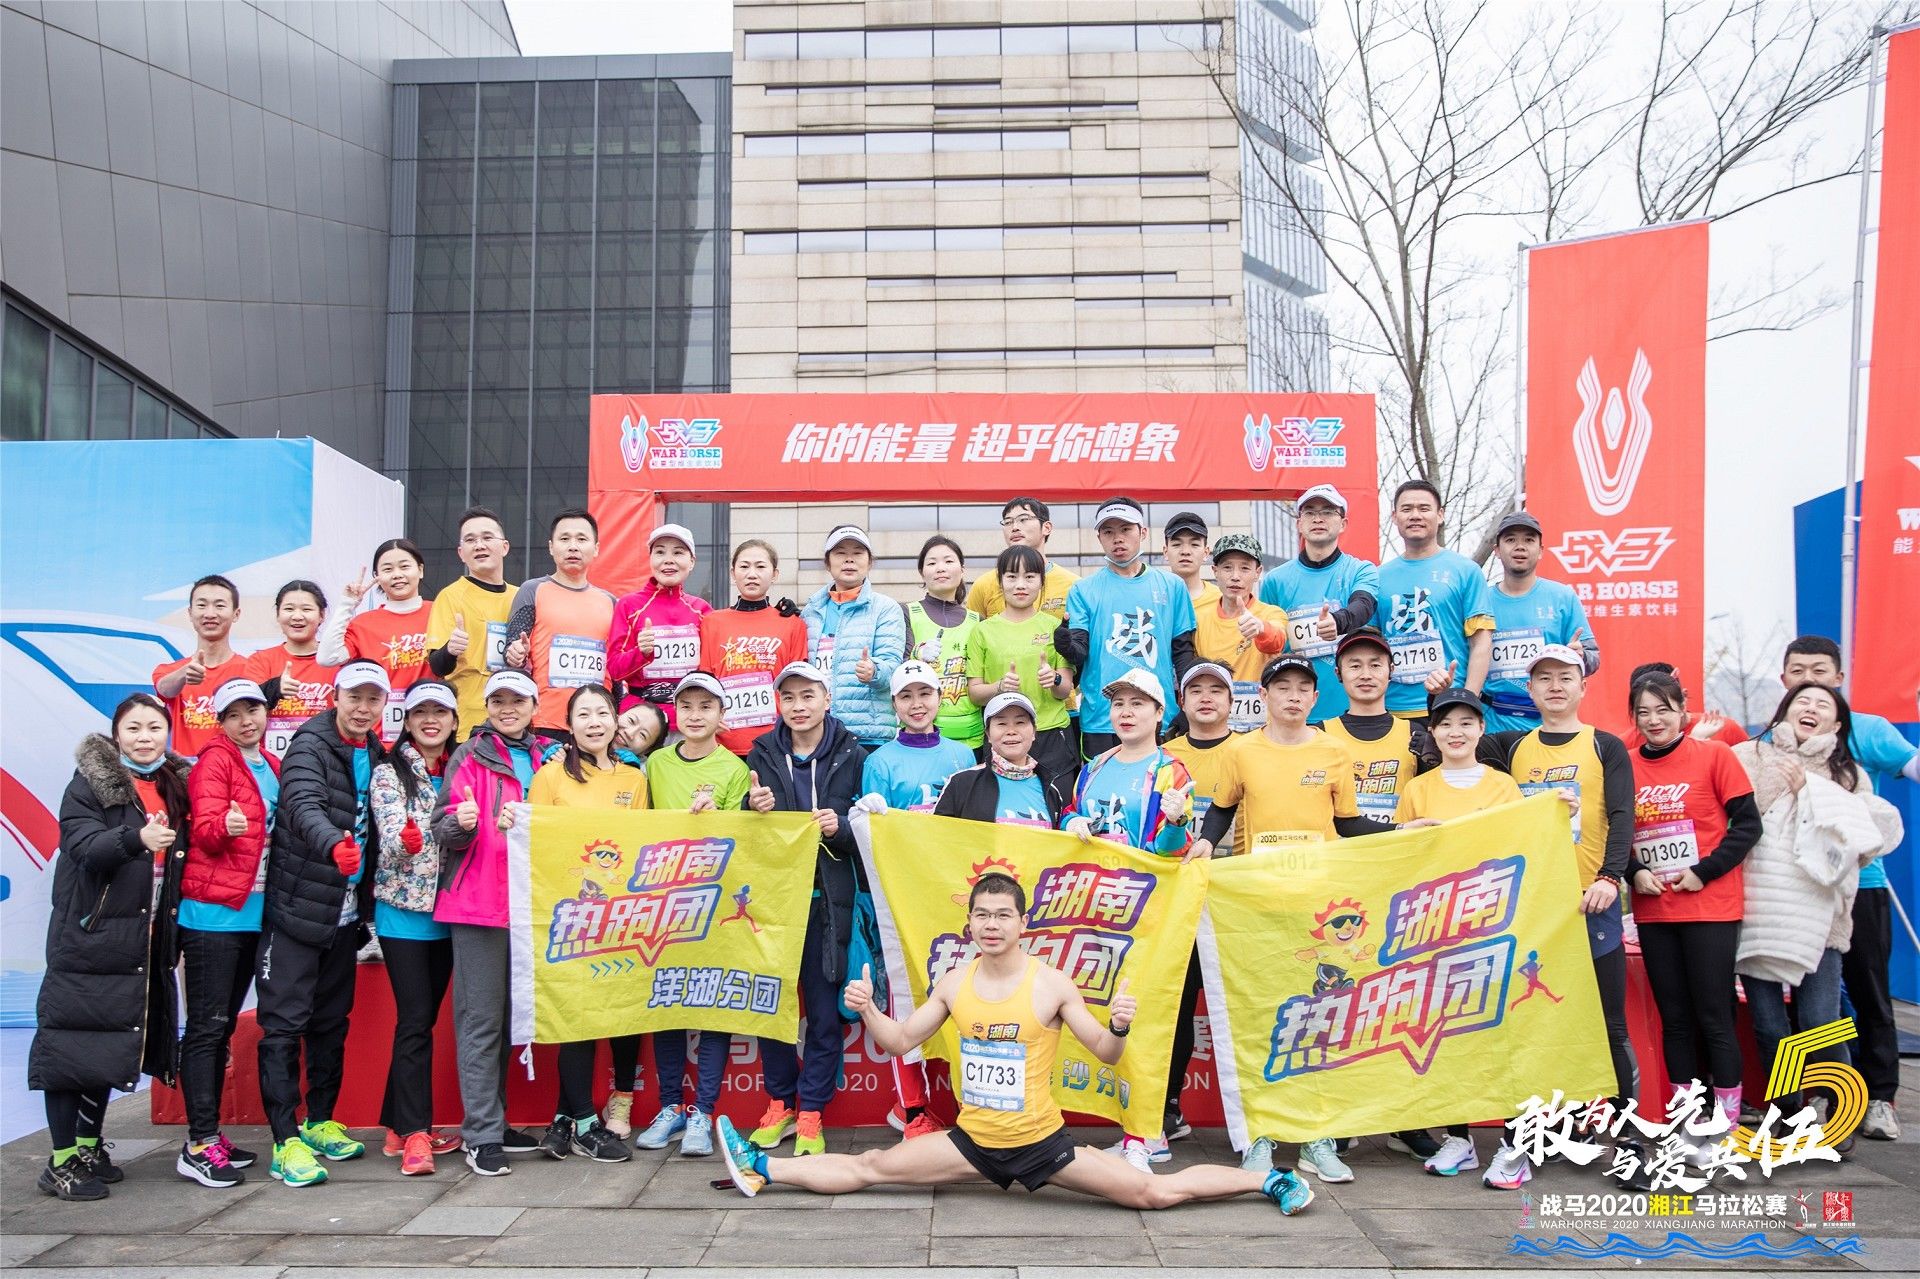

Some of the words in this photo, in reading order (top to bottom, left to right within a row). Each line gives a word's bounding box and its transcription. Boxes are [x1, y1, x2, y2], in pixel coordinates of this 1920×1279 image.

[781, 423, 957, 463] 你的能量
[962, 422, 1180, 463] 超乎你想象
[1276, 447, 1300, 457] WAR
[1304, 447, 1344, 457] HORSE
[651, 448, 677, 458] WAR
[680, 448, 721, 458] HORSE
[1893, 536, 1920, 555] 能
[1596, 580, 1679, 600] HORSE
[1105, 605, 1158, 669] 战
[653, 642, 696, 660] D1213
[1392, 647, 1437, 666] C1718
[1492, 644, 1537, 661] C1723
[559, 653, 602, 671] C1726
[725, 690, 769, 710] D1216
[1230, 700, 1261, 714] 716
[1368, 760, 1399, 776] 湖南
[1640, 841, 1690, 864] D1302
[633, 841, 730, 887] 湖南
[1032, 870, 1149, 924] 湖南
[1386, 863, 1517, 957] 湖南
[550, 889, 714, 960] 热跑团
[647, 967, 782, 1014] 洋湖分团
[1269, 941, 1511, 1074] 热跑团
[836, 1073, 878, 1092] 020
[966, 1062, 1016, 1086] C1733
